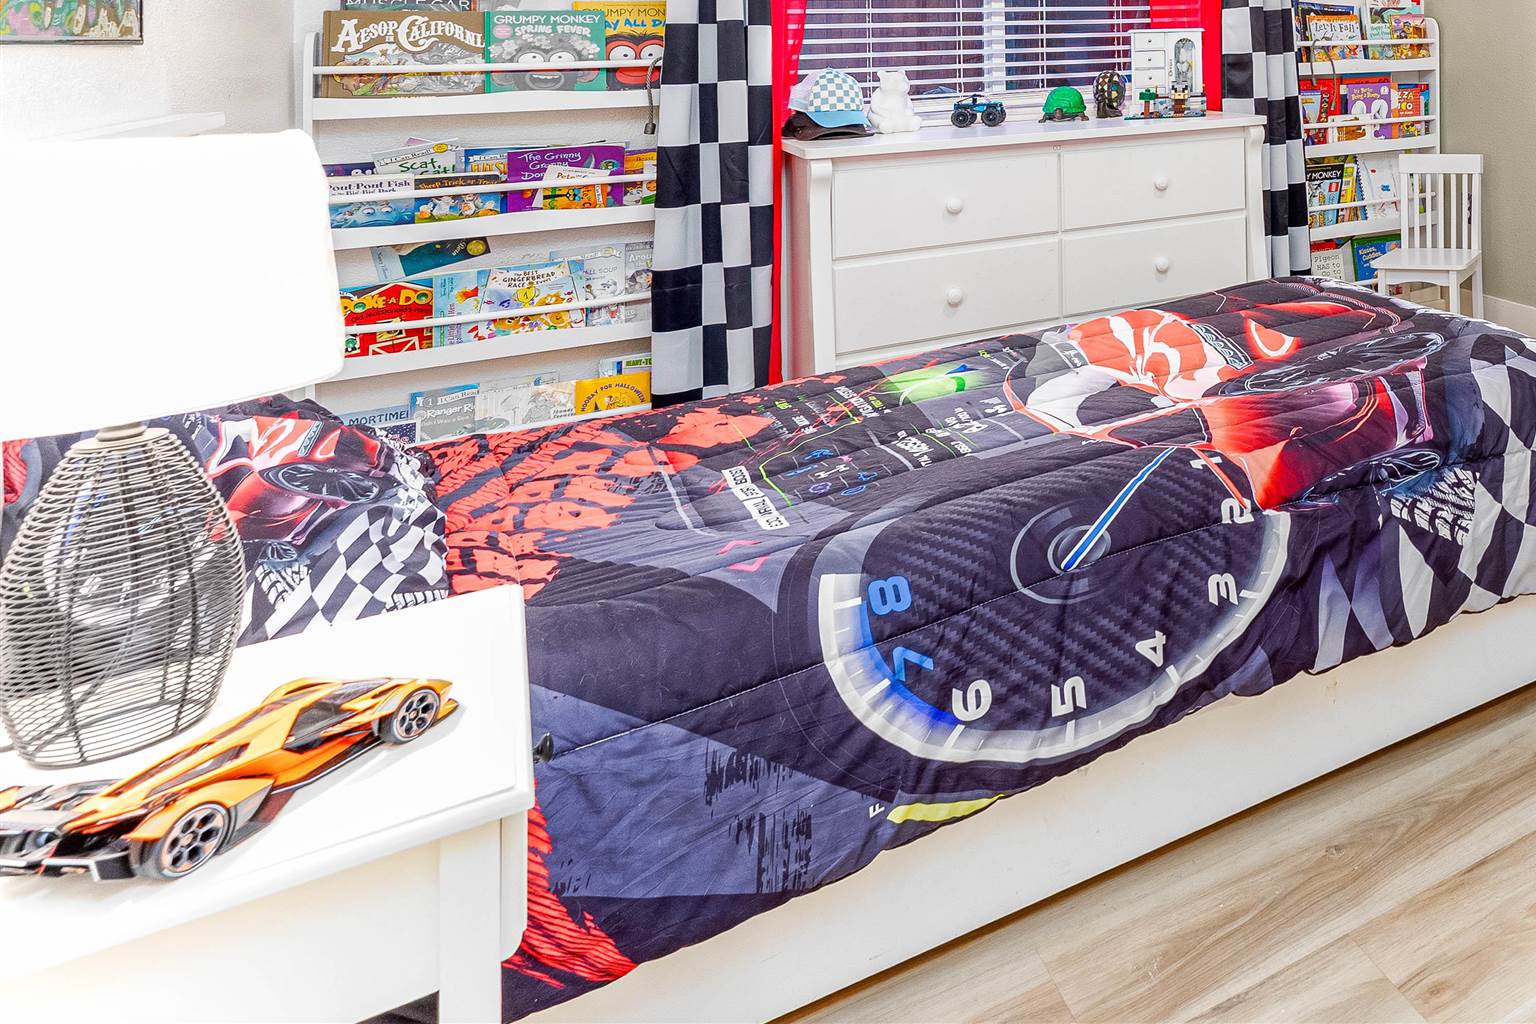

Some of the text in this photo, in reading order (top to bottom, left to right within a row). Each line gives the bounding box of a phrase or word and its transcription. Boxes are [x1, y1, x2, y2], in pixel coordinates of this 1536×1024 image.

[494, 14, 600, 24] GRUMPY MONKEY
[624, 17, 646, 27] ALL
[396, 15, 485, 51] CALIFORNI
[515, 25, 553, 36] SPRING
[557, 25, 592, 37] FEVER
[399, 158, 441, 172] Scat,
[518, 152, 541, 163] The
[1312, 170, 1342, 179] MONKEY
[388, 180, 410, 188] Fish
[503, 271, 556, 283] GINGERBREAD
[581, 388, 598, 412] HOORAY
[615, 383, 646, 403] HALLOWEEN
[348, 410, 409, 426] MORTIME
[426, 406, 462, 418] Ranger
[1191, 455, 1223, 470] 1
[1222, 499, 1255, 524] 2
[867, 577, 913, 615] 8
[1208, 573, 1239, 606] 3
[1135, 629, 1169, 668] 4
[891, 645, 934, 682] 7
[952, 678, 992, 722] 6
[1051, 675, 1087, 716] 5
